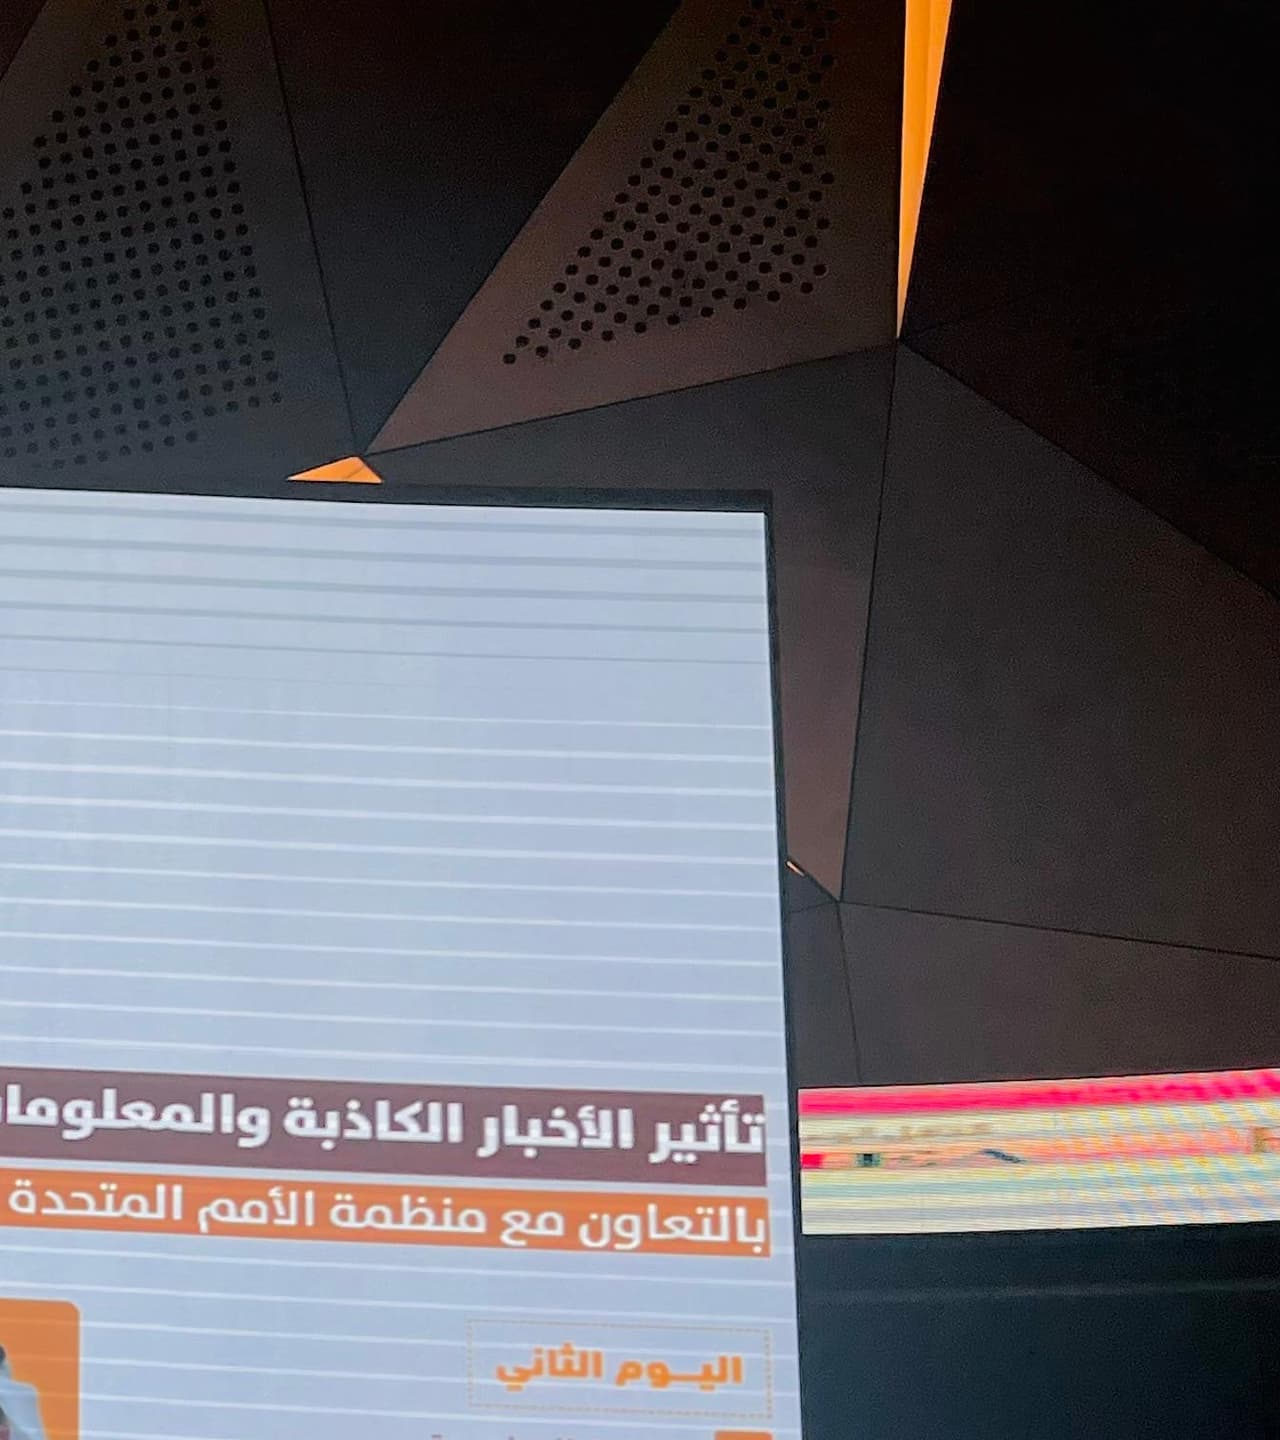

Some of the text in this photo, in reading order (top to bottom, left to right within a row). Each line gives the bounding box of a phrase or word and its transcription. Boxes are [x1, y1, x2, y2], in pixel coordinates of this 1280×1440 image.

[283, 1096, 464, 1151] الكاذبة
[476, 1100, 635, 1158] الأخبار
[647, 1100, 766, 1164] تأثير
[8, 1178, 183, 1221] المتحدة
[198, 1186, 315, 1234] الأمم
[329, 1192, 487, 1234] منظمة
[499, 1207, 565, 1247] مع
[578, 1203, 767, 1255] بالتعاون
[496, 1342, 742, 1392] اليوم الثاني
